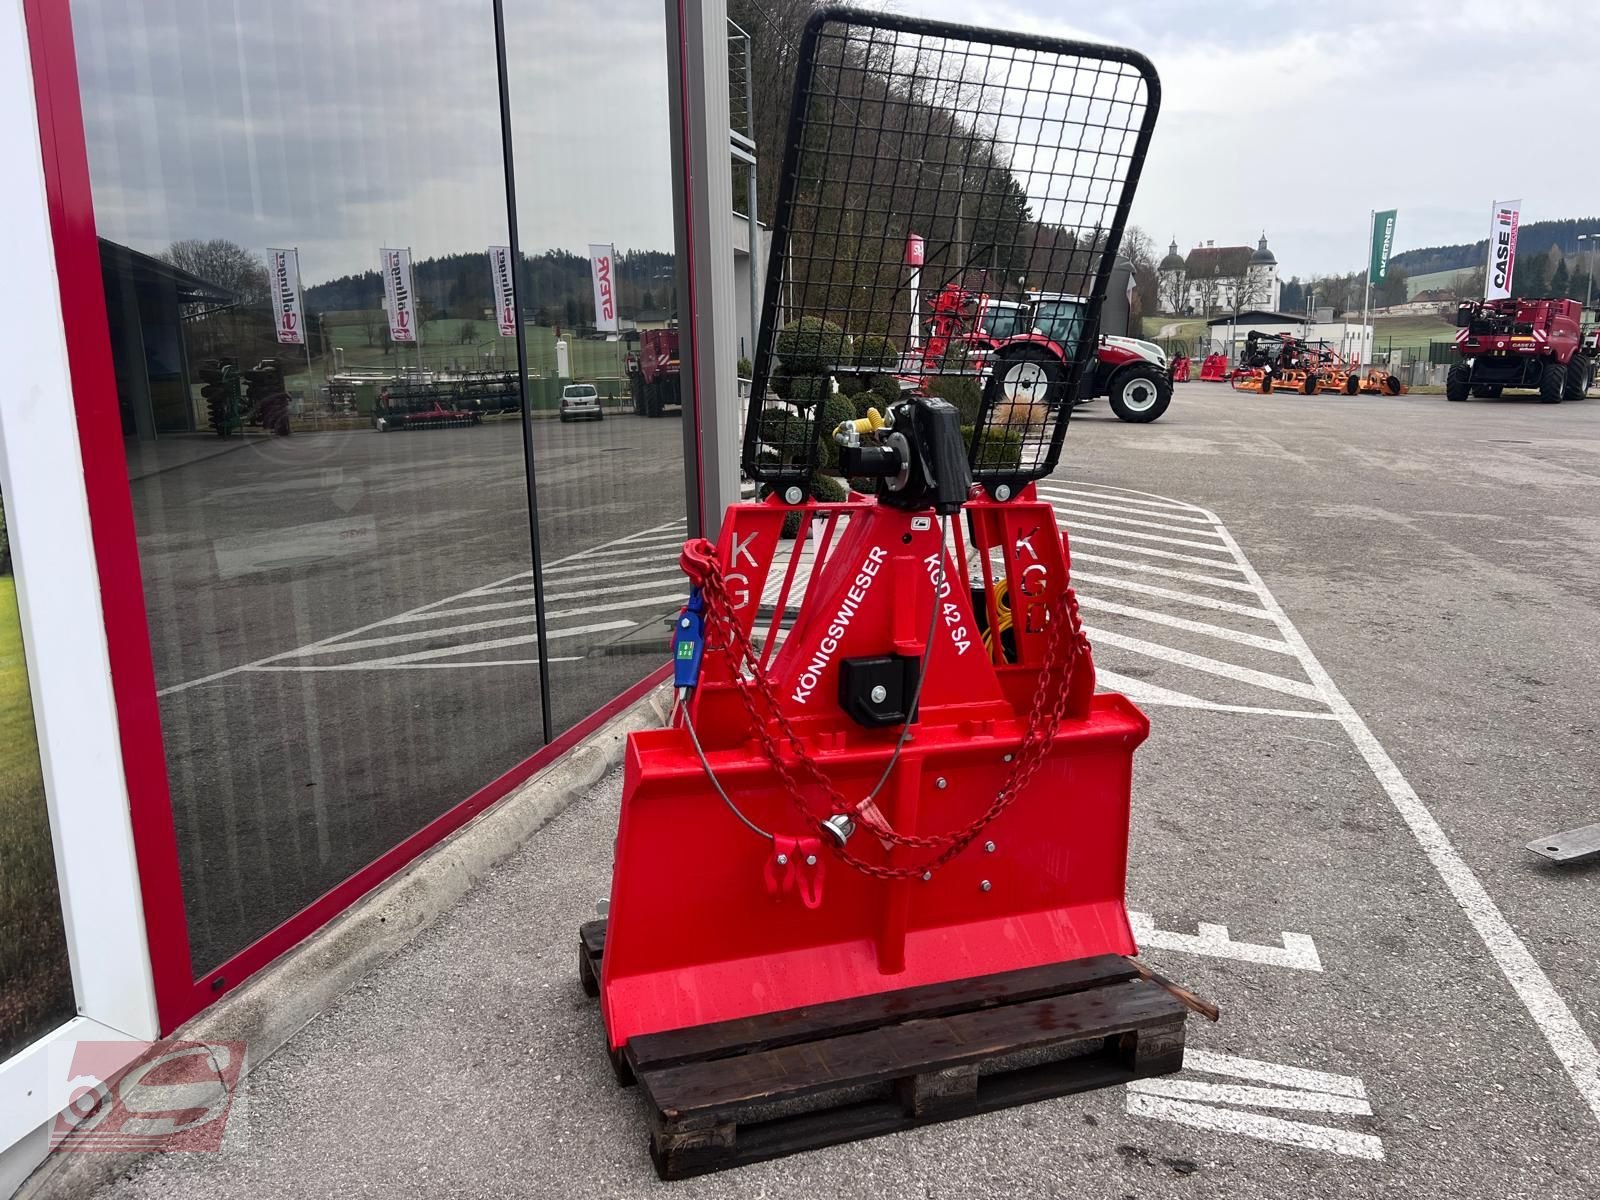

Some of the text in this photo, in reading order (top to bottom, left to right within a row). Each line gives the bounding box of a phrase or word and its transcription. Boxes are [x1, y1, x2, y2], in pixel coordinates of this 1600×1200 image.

[1494, 231, 1511, 289] CASE
[791, 546, 888, 704] KÖNIGSWIESER
[923, 553, 971, 655] KGD 42 SA
